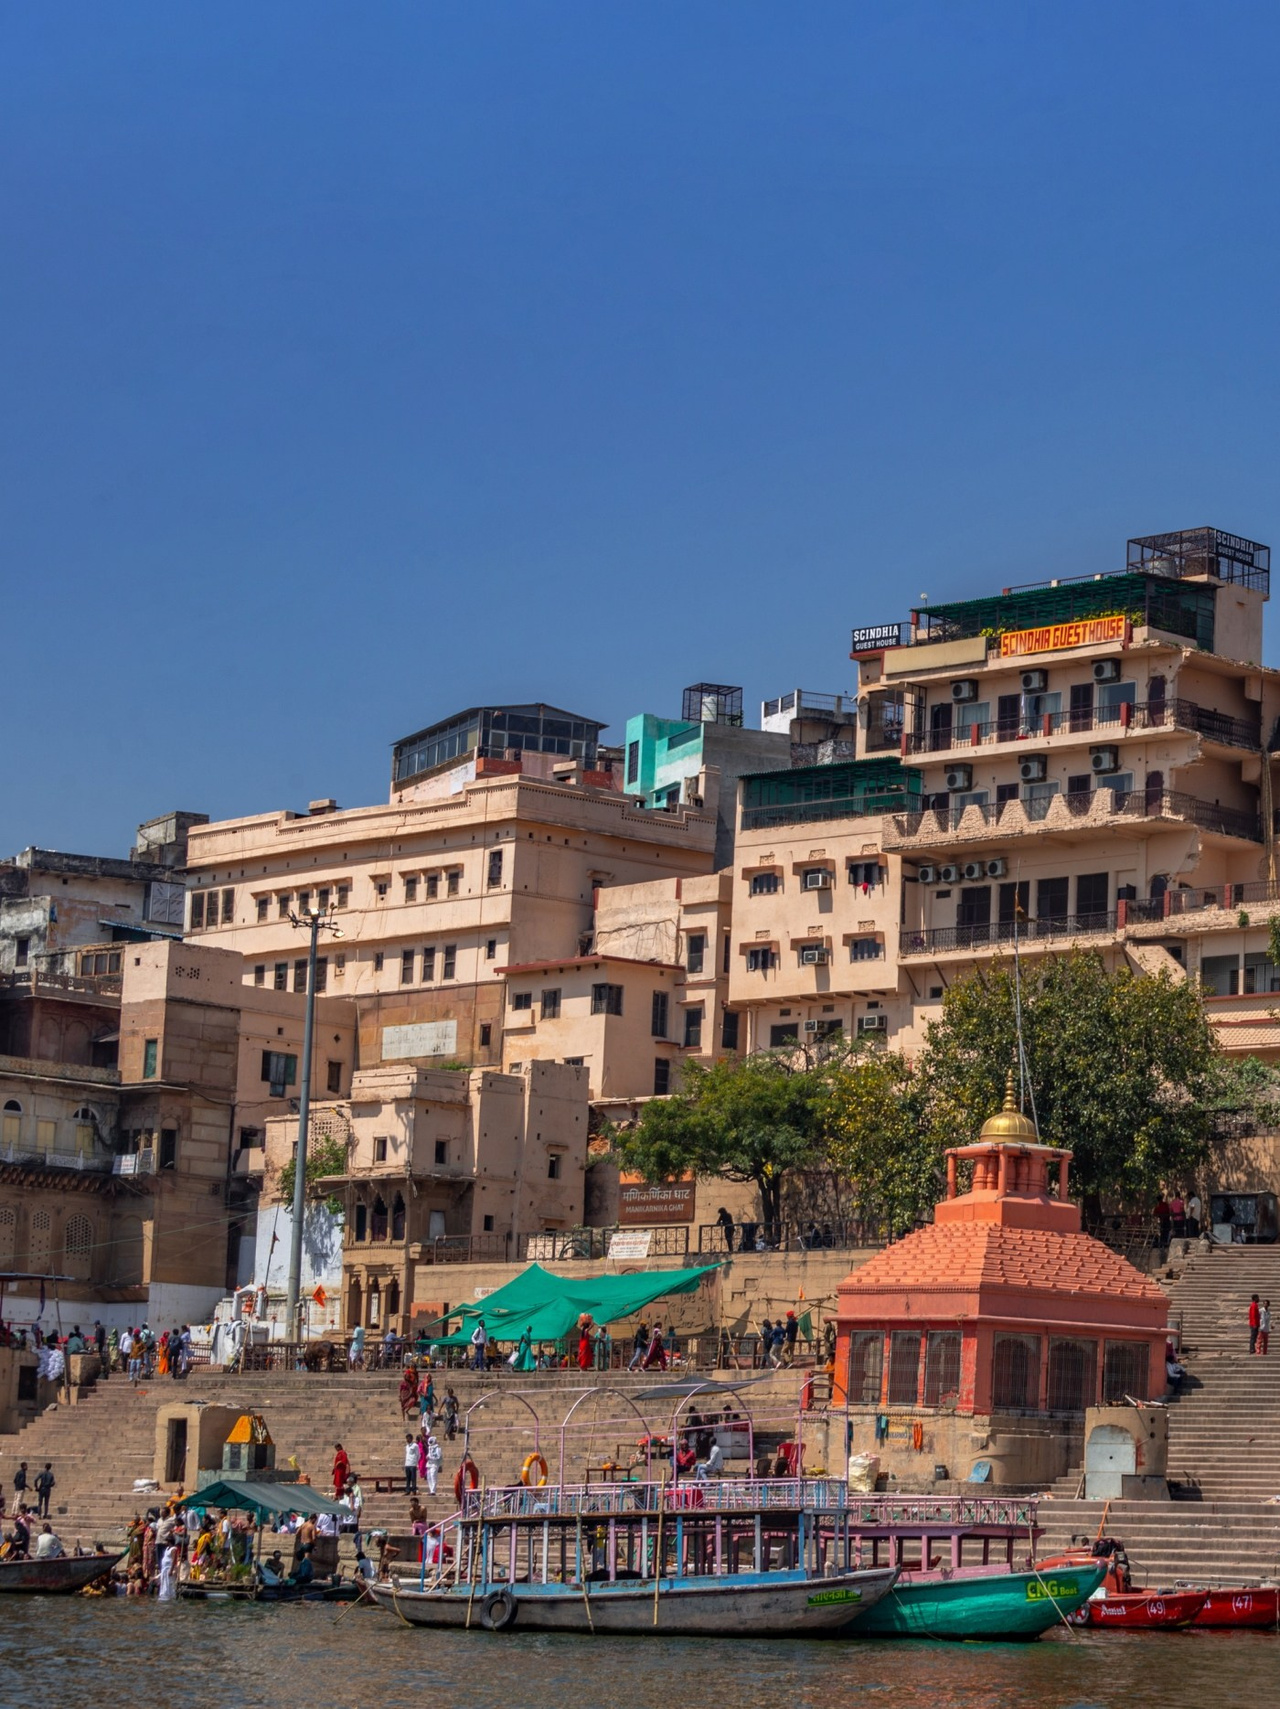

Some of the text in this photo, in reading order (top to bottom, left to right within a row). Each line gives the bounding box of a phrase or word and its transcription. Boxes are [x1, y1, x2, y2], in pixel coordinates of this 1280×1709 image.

[1217, 531, 1254, 554] SCINDHIA
[853, 625, 899, 641] SCINDHIA
[1002, 617, 1124, 656] SCINDHIA GUEST HOUSE
[855, 638, 897, 650] GUEST HOUSE
[674, 1189, 691, 1199] घाट
[626, 1204, 684, 1213] MANIKARNIKA GHAT
[1027, 1580, 1078, 1598] CNG Boat
[1146, 1600, 1166, 1618] (49)
[1232, 1595, 1253, 1614] (47)
